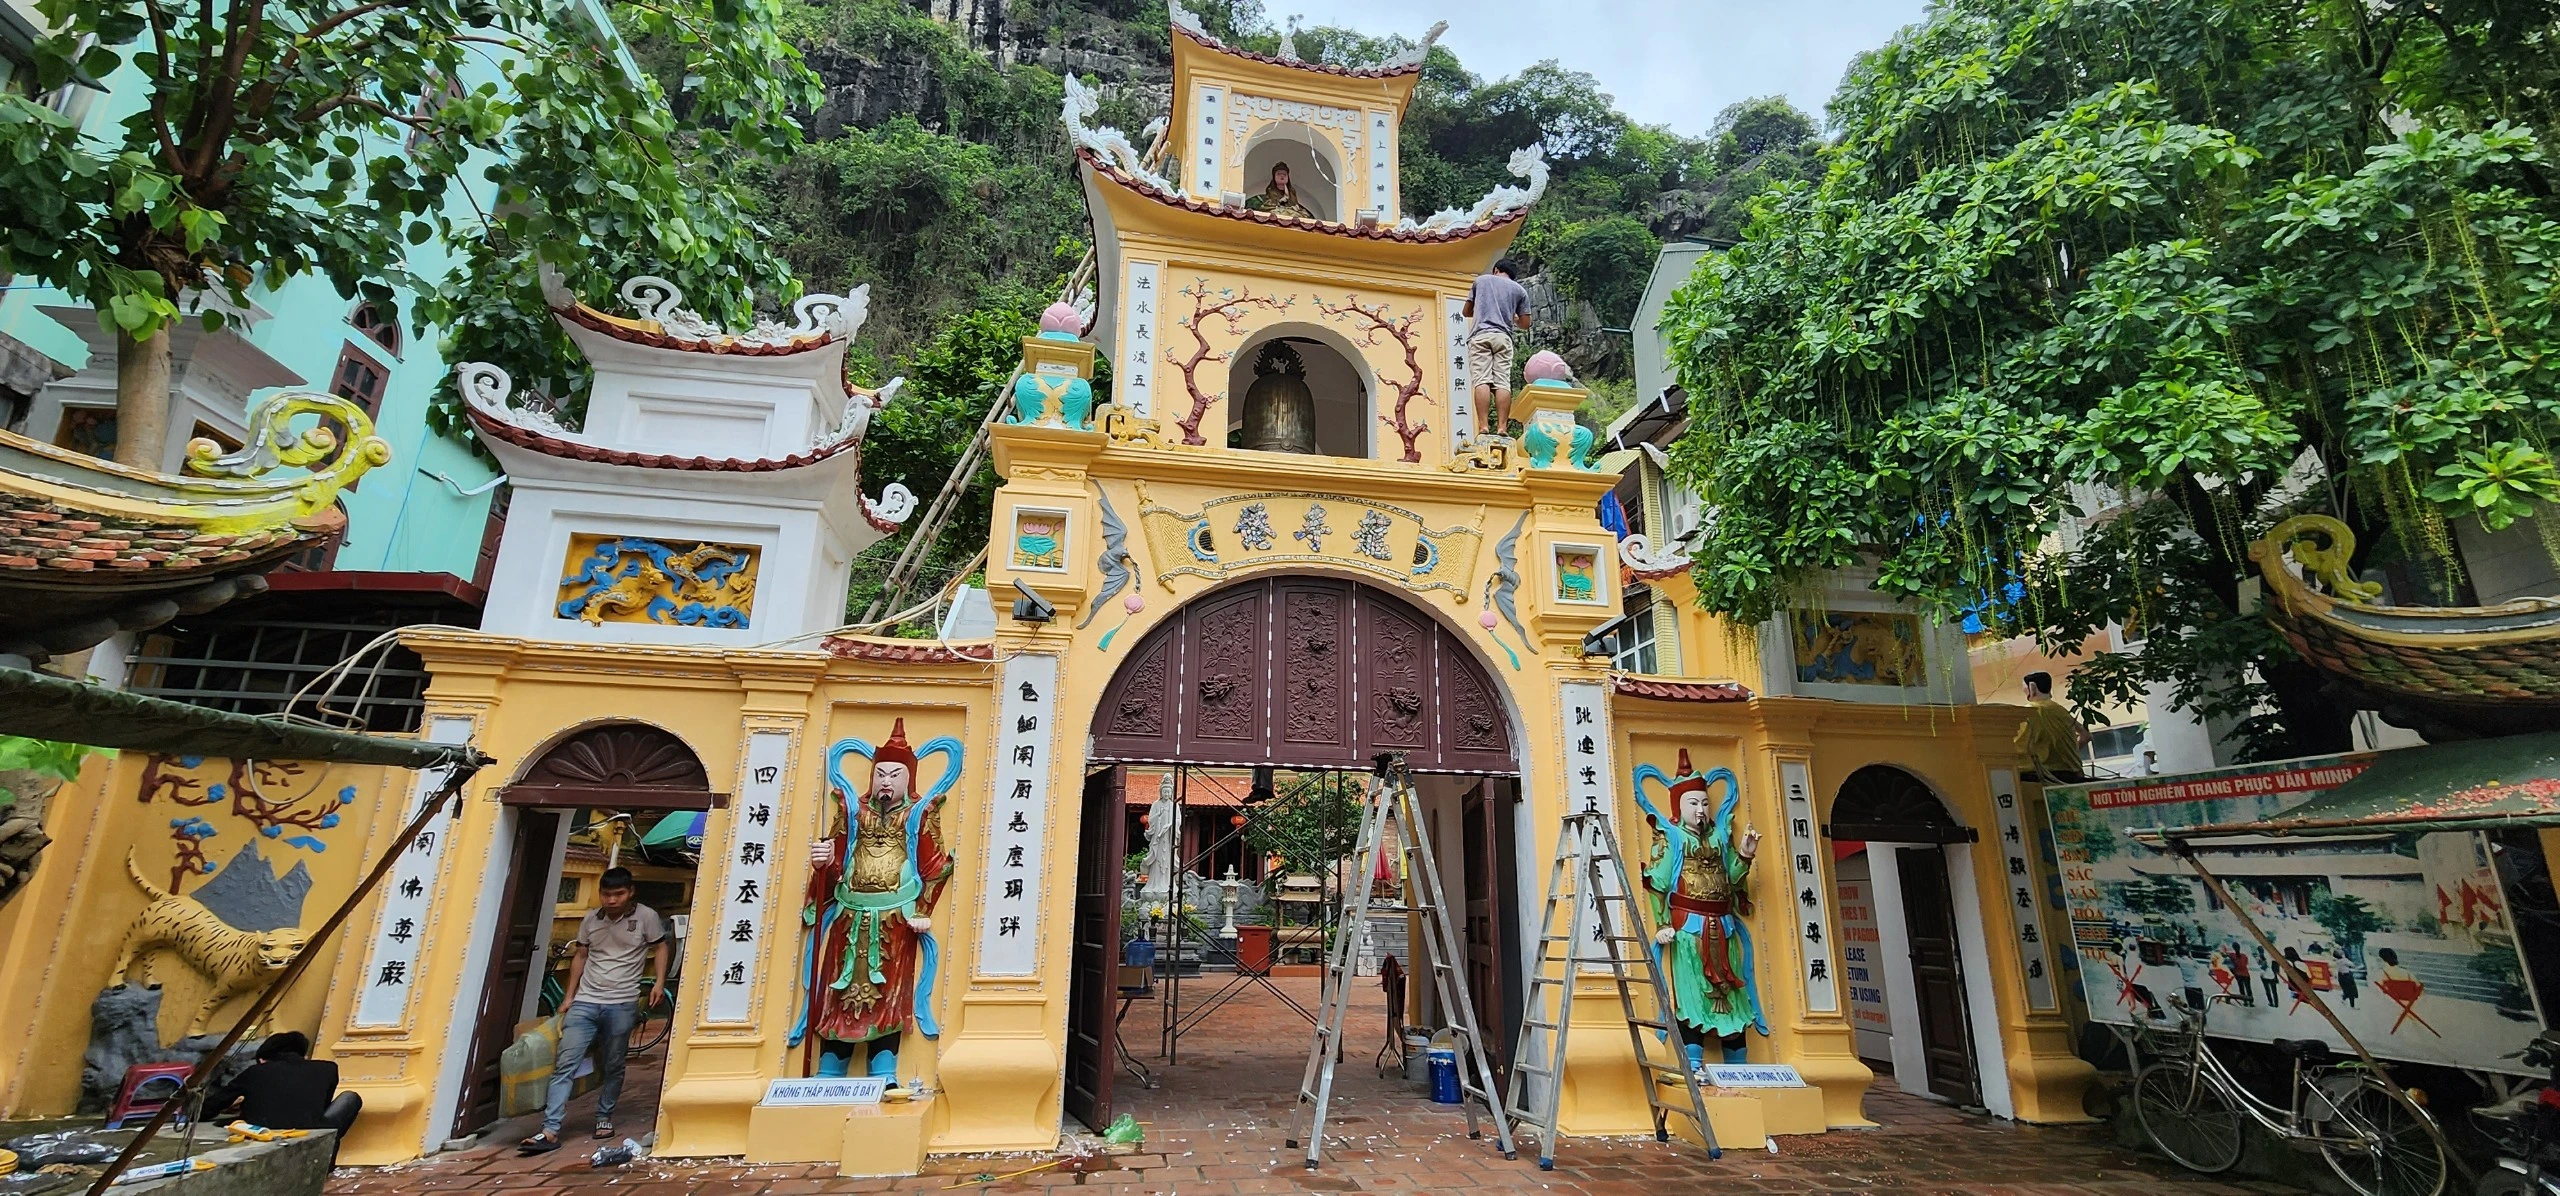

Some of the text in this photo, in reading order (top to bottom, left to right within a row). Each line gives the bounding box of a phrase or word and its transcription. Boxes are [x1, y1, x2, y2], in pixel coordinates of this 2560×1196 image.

[2114, 789, 2136, 803] TÔN
[2139, 784, 2186, 801] NGHIÊM
[2188, 780, 2232, 797] TRANG
[2234, 776, 2273, 794] PHỤC
[2275, 771, 2307, 788] VĂN
[2310, 768, 2353, 785] MINH
[1841, 906, 1857, 920] THES
[1845, 946, 1866, 962] LEASE
[1847, 966, 1869, 982] ETURN
[1859, 987, 1881, 1003] USING
[772, 1084, 801, 1098] KHÔNG
[823, 1085, 851, 1098] HƯƠNG
[136, 1166, 165, 1176] APOLLO
